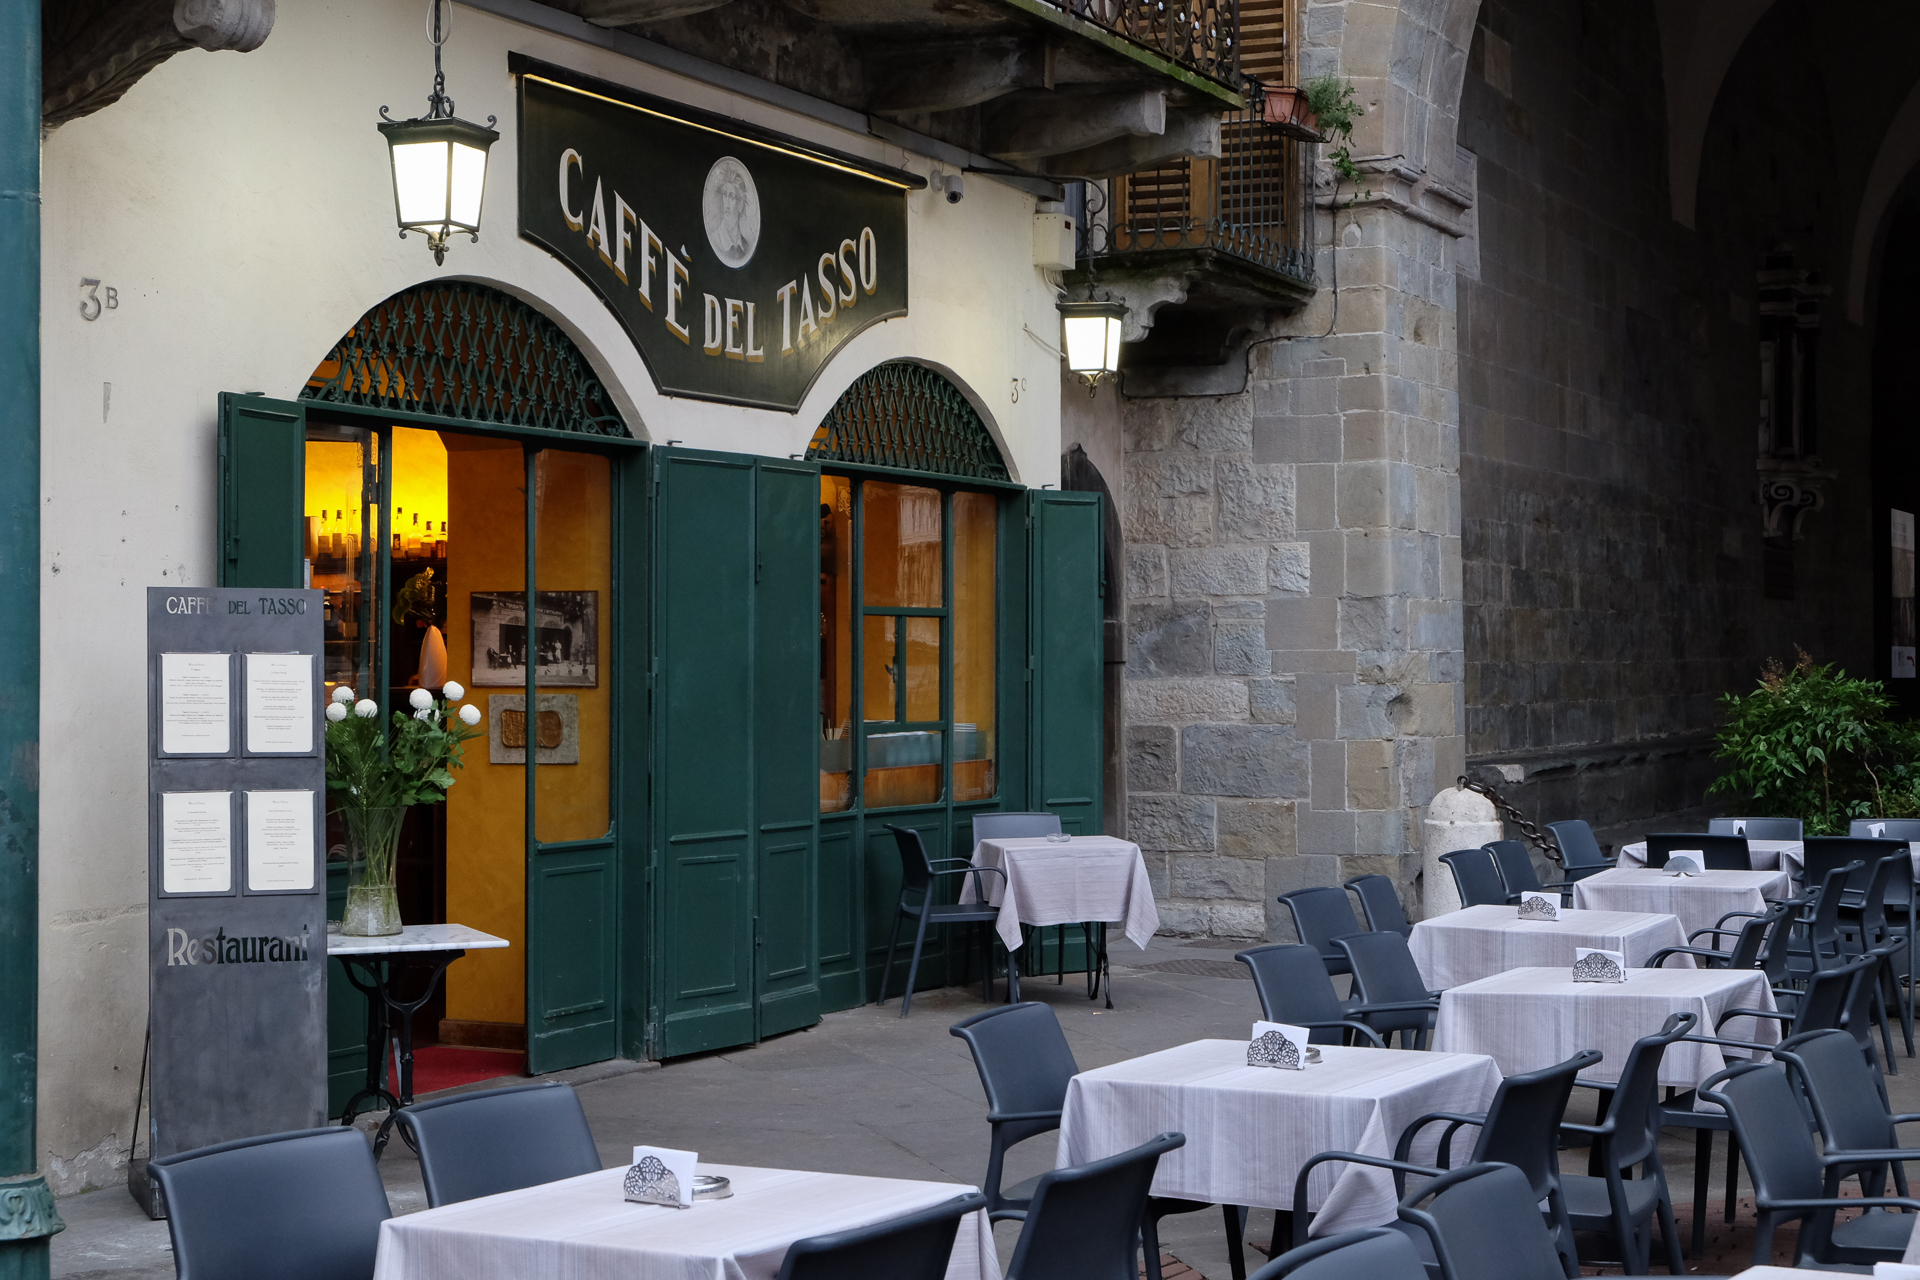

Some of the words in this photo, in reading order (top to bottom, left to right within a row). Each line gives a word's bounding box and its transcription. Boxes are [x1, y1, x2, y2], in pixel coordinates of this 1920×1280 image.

[559, 147, 692, 346] CAFFÈ
[702, 292, 764, 363] DEL
[777, 226, 877, 358] TASSO
[79, 277, 119, 322] 3B
[228, 600, 251, 615] DEL
[259, 597, 307, 615] TASSO
[167, 924, 310, 966] Restaurant
